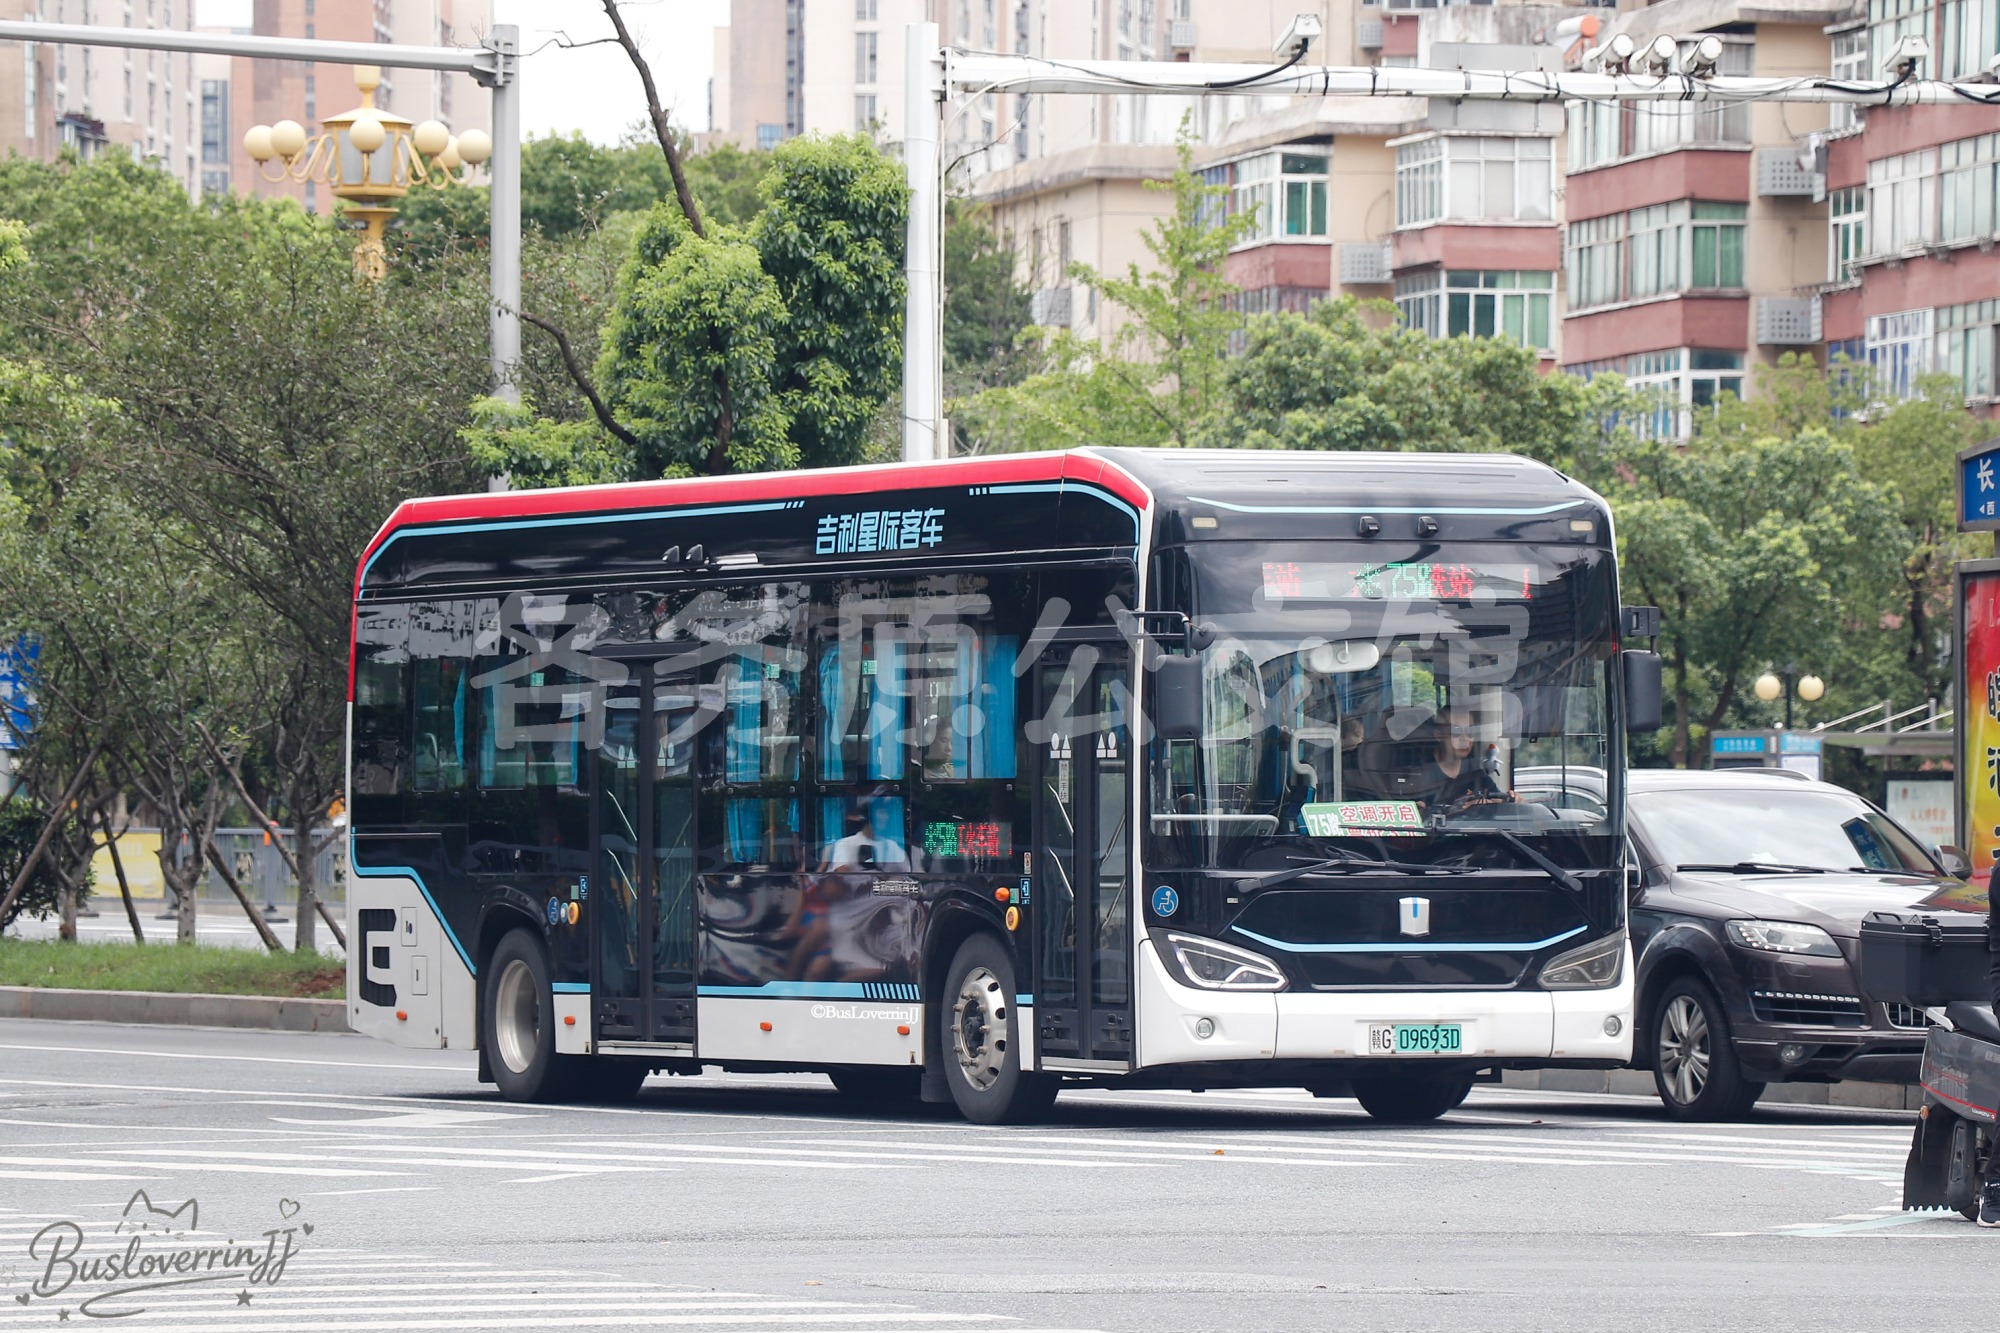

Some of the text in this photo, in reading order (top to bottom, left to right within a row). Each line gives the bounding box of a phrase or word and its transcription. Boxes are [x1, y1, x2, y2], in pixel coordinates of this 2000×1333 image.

[1976, 458, 1995, 493] 长
[815, 508, 946, 555] 吉利星际客车
[1339, 805, 1417, 824] 空调开启
